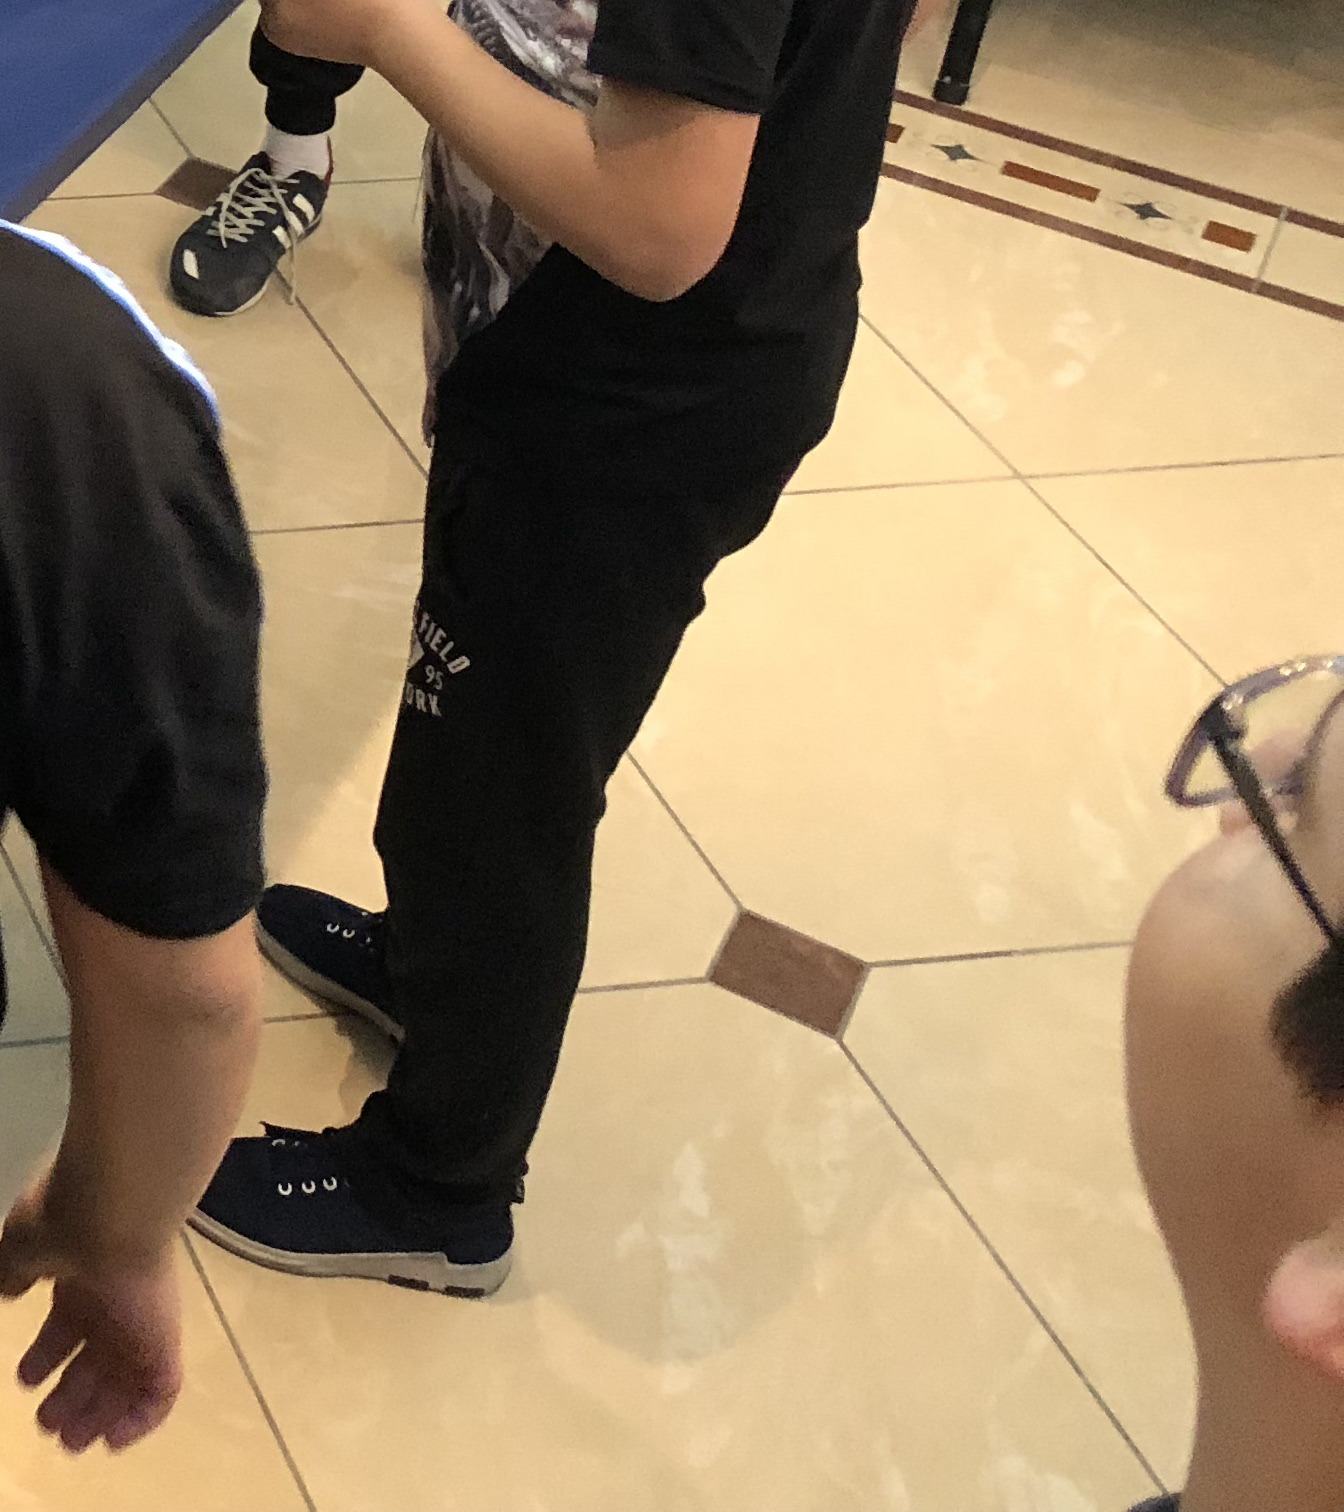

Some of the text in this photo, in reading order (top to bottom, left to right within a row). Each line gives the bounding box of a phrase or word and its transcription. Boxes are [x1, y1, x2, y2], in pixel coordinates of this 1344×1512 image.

[416, 610, 471, 675] FIELD
[425, 664, 443, 690] 95
[405, 682, 442, 717] ORK
